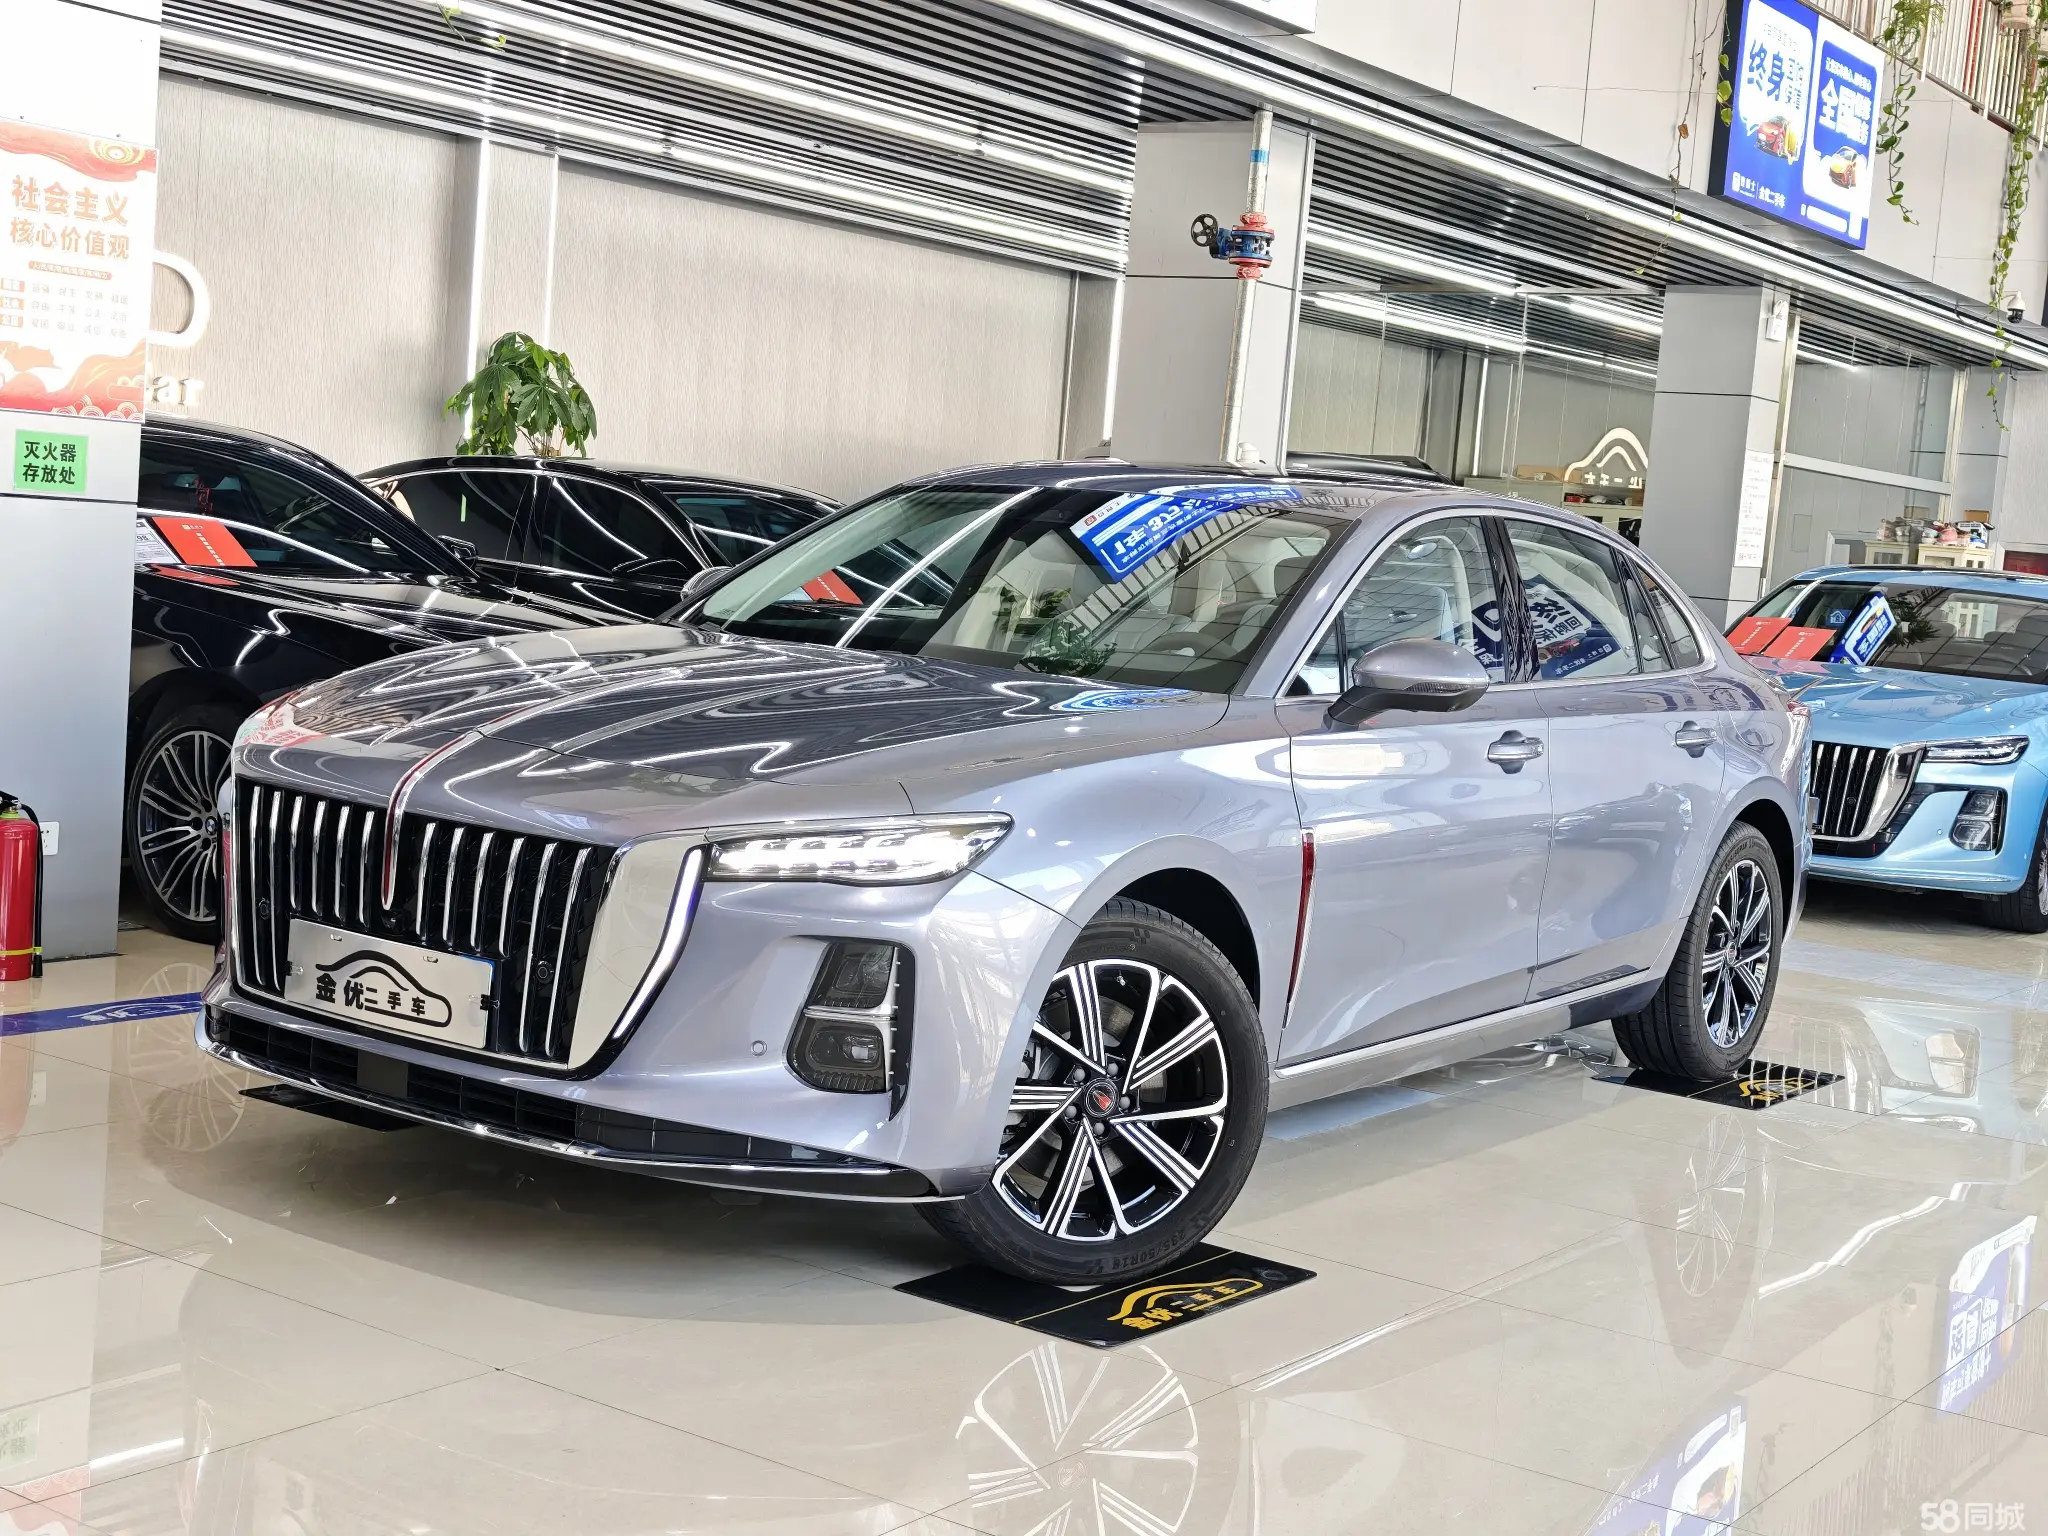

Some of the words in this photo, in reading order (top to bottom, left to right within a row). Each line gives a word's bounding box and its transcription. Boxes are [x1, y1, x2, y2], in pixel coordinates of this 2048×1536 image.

[1747, 38, 1785, 101] 终身
[11, 175, 129, 226] 社会主义
[10, 217, 130, 261] 核心价值观
[146, 376, 204, 406] ar
[23, 440, 77, 463] 灭火器
[22, 462, 76, 485] 存放处
[316, 973, 426, 1016] 金优二手车
[1121, 1285, 1238, 1330] 金优二手车
